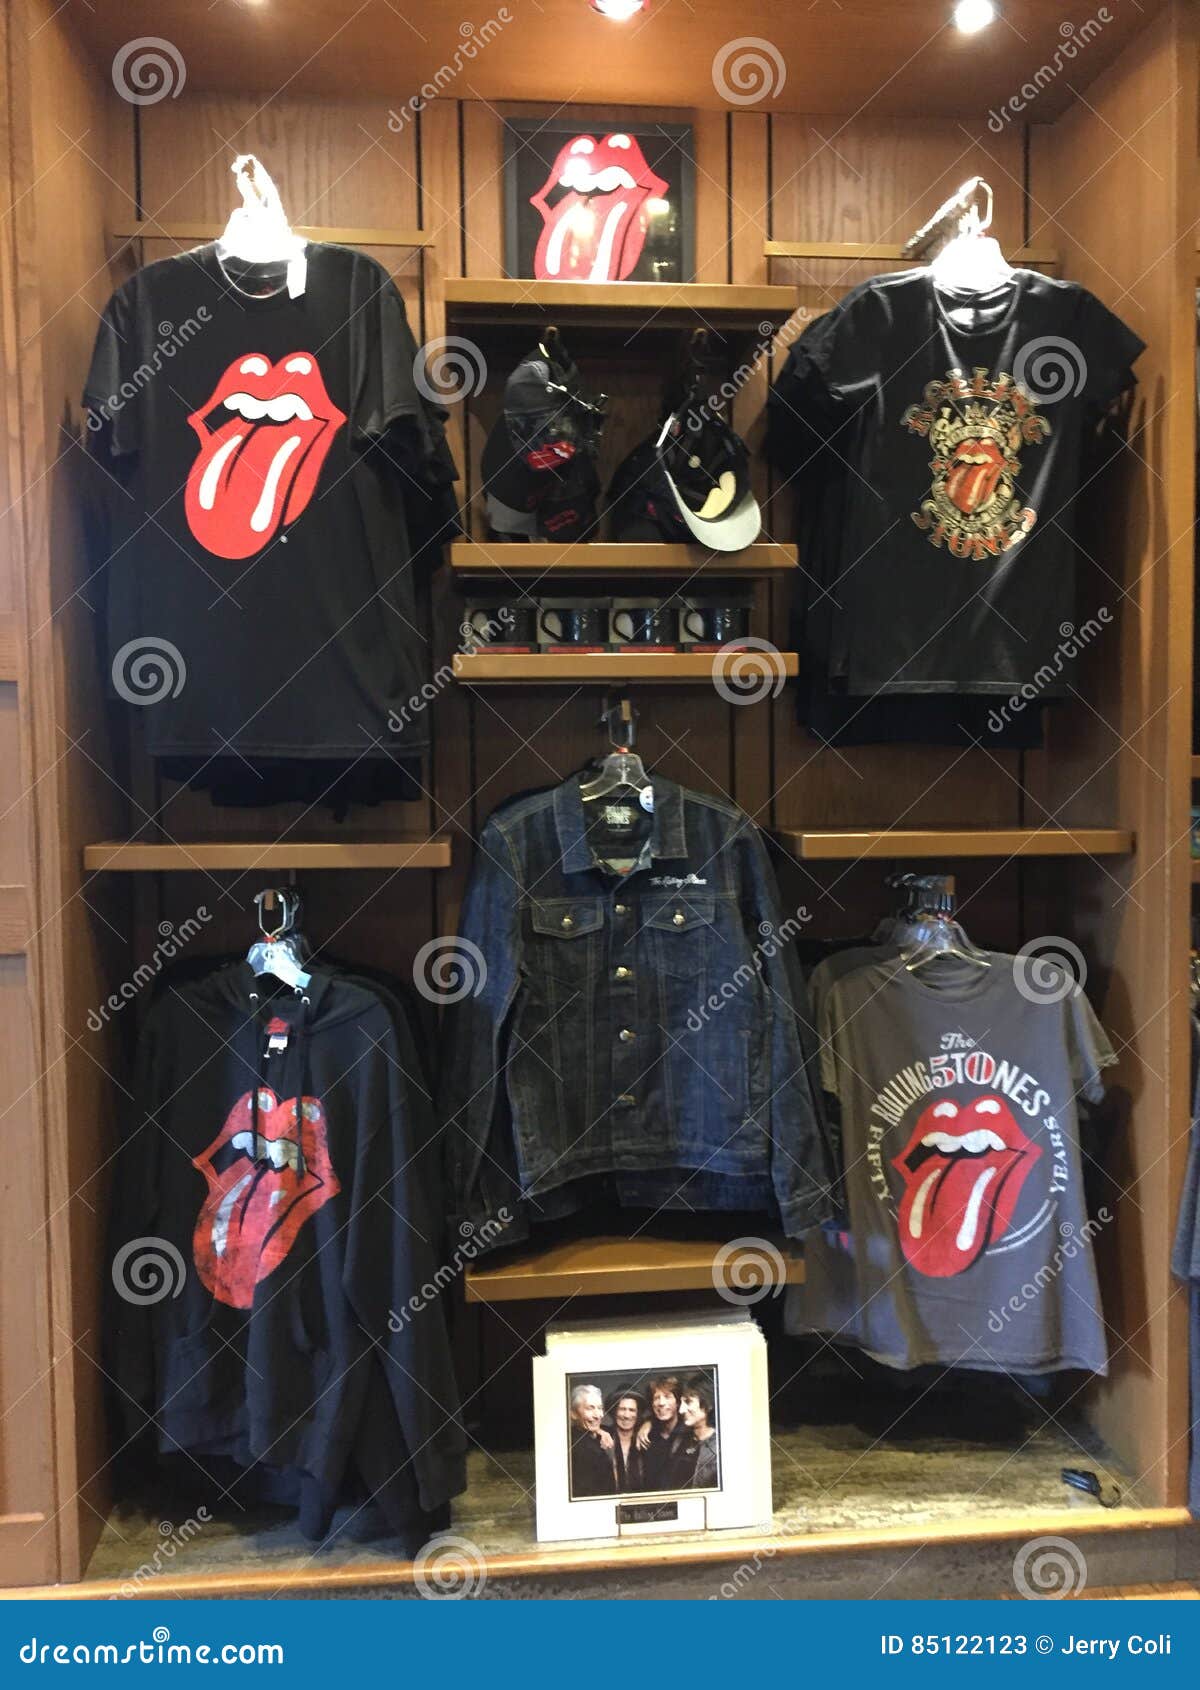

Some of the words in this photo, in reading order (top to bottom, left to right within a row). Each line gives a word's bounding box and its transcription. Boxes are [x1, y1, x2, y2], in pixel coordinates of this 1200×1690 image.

[940, 1032, 977, 1050] The
[871, 1061, 934, 1127] ROLLING
[1043, 1116, 1069, 1193] YEARS
